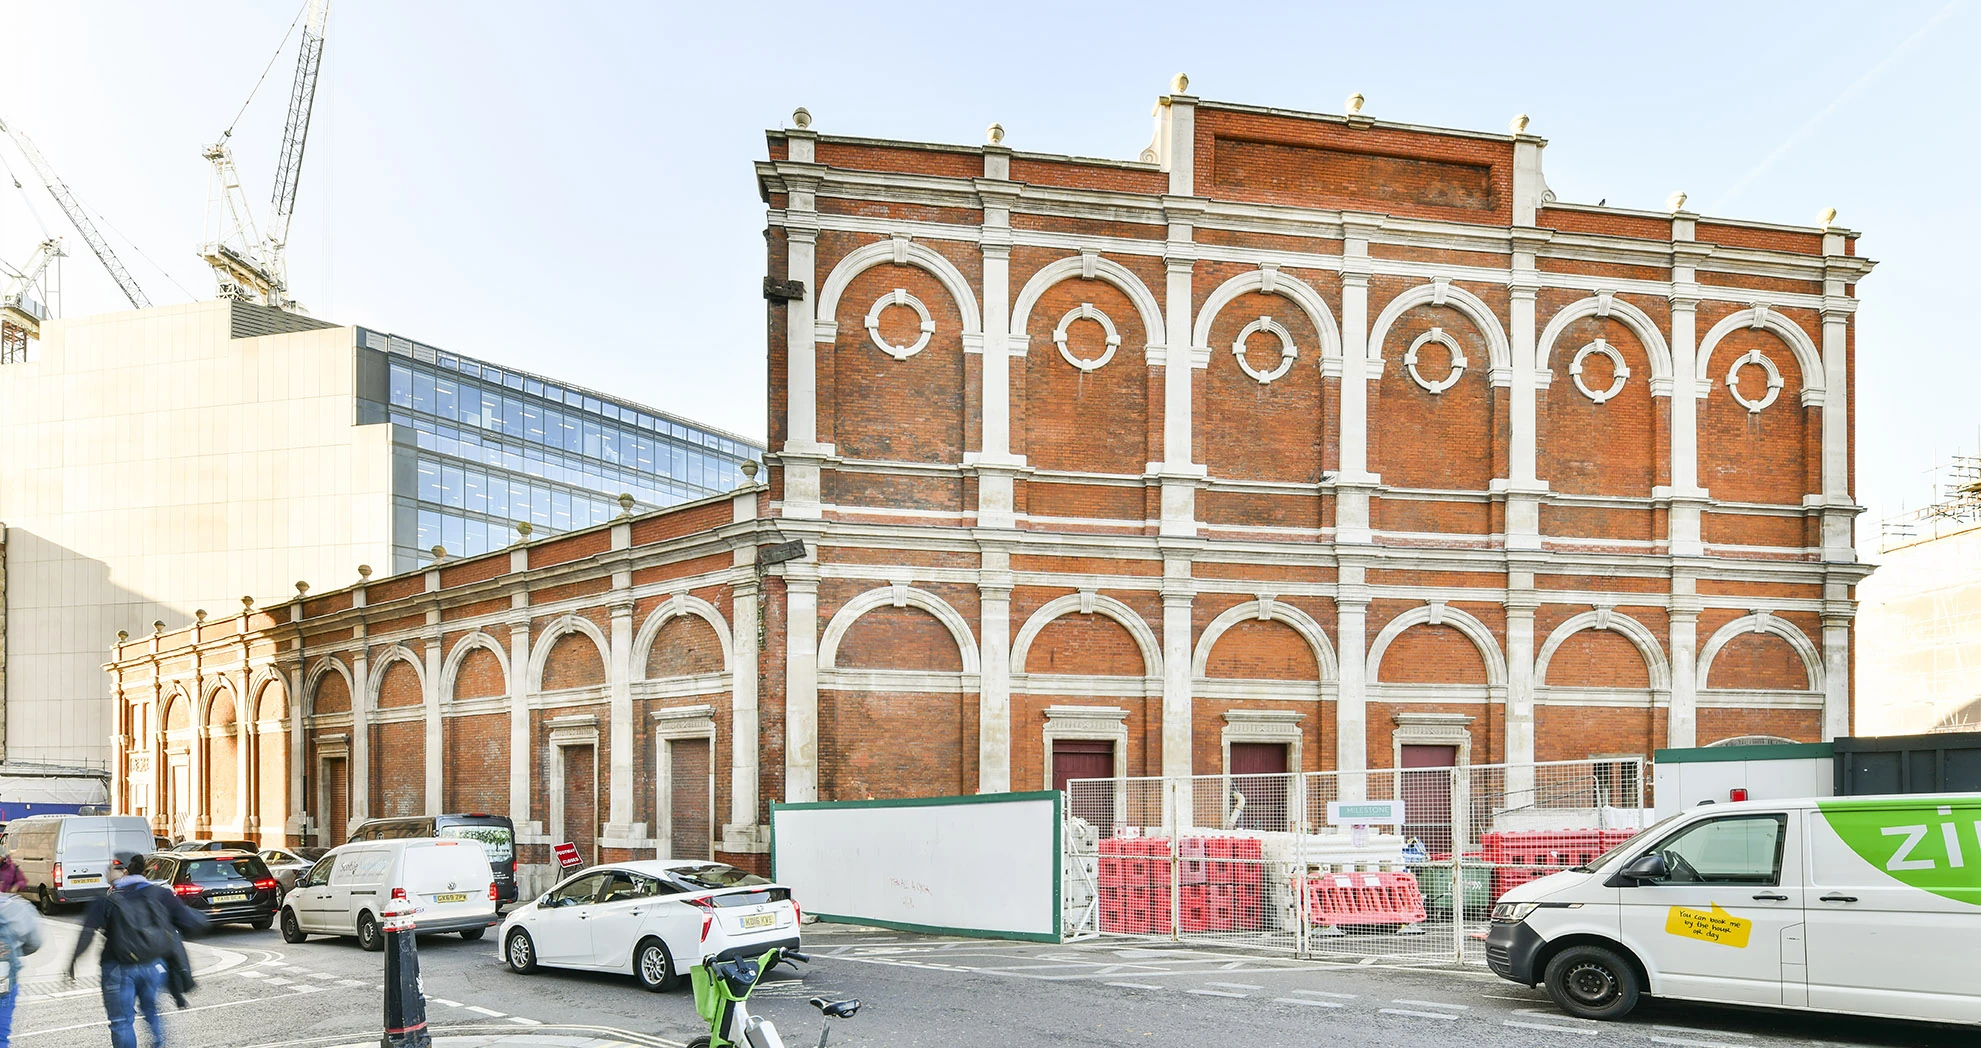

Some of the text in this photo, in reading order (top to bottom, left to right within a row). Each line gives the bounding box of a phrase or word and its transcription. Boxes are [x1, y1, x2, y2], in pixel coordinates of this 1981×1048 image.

[1679, 910, 1692, 919] You
[1709, 917, 1727, 925] book
[1684, 920, 1693, 928] by
[1696, 920, 1709, 929] the
[1705, 931, 1719, 941] day
